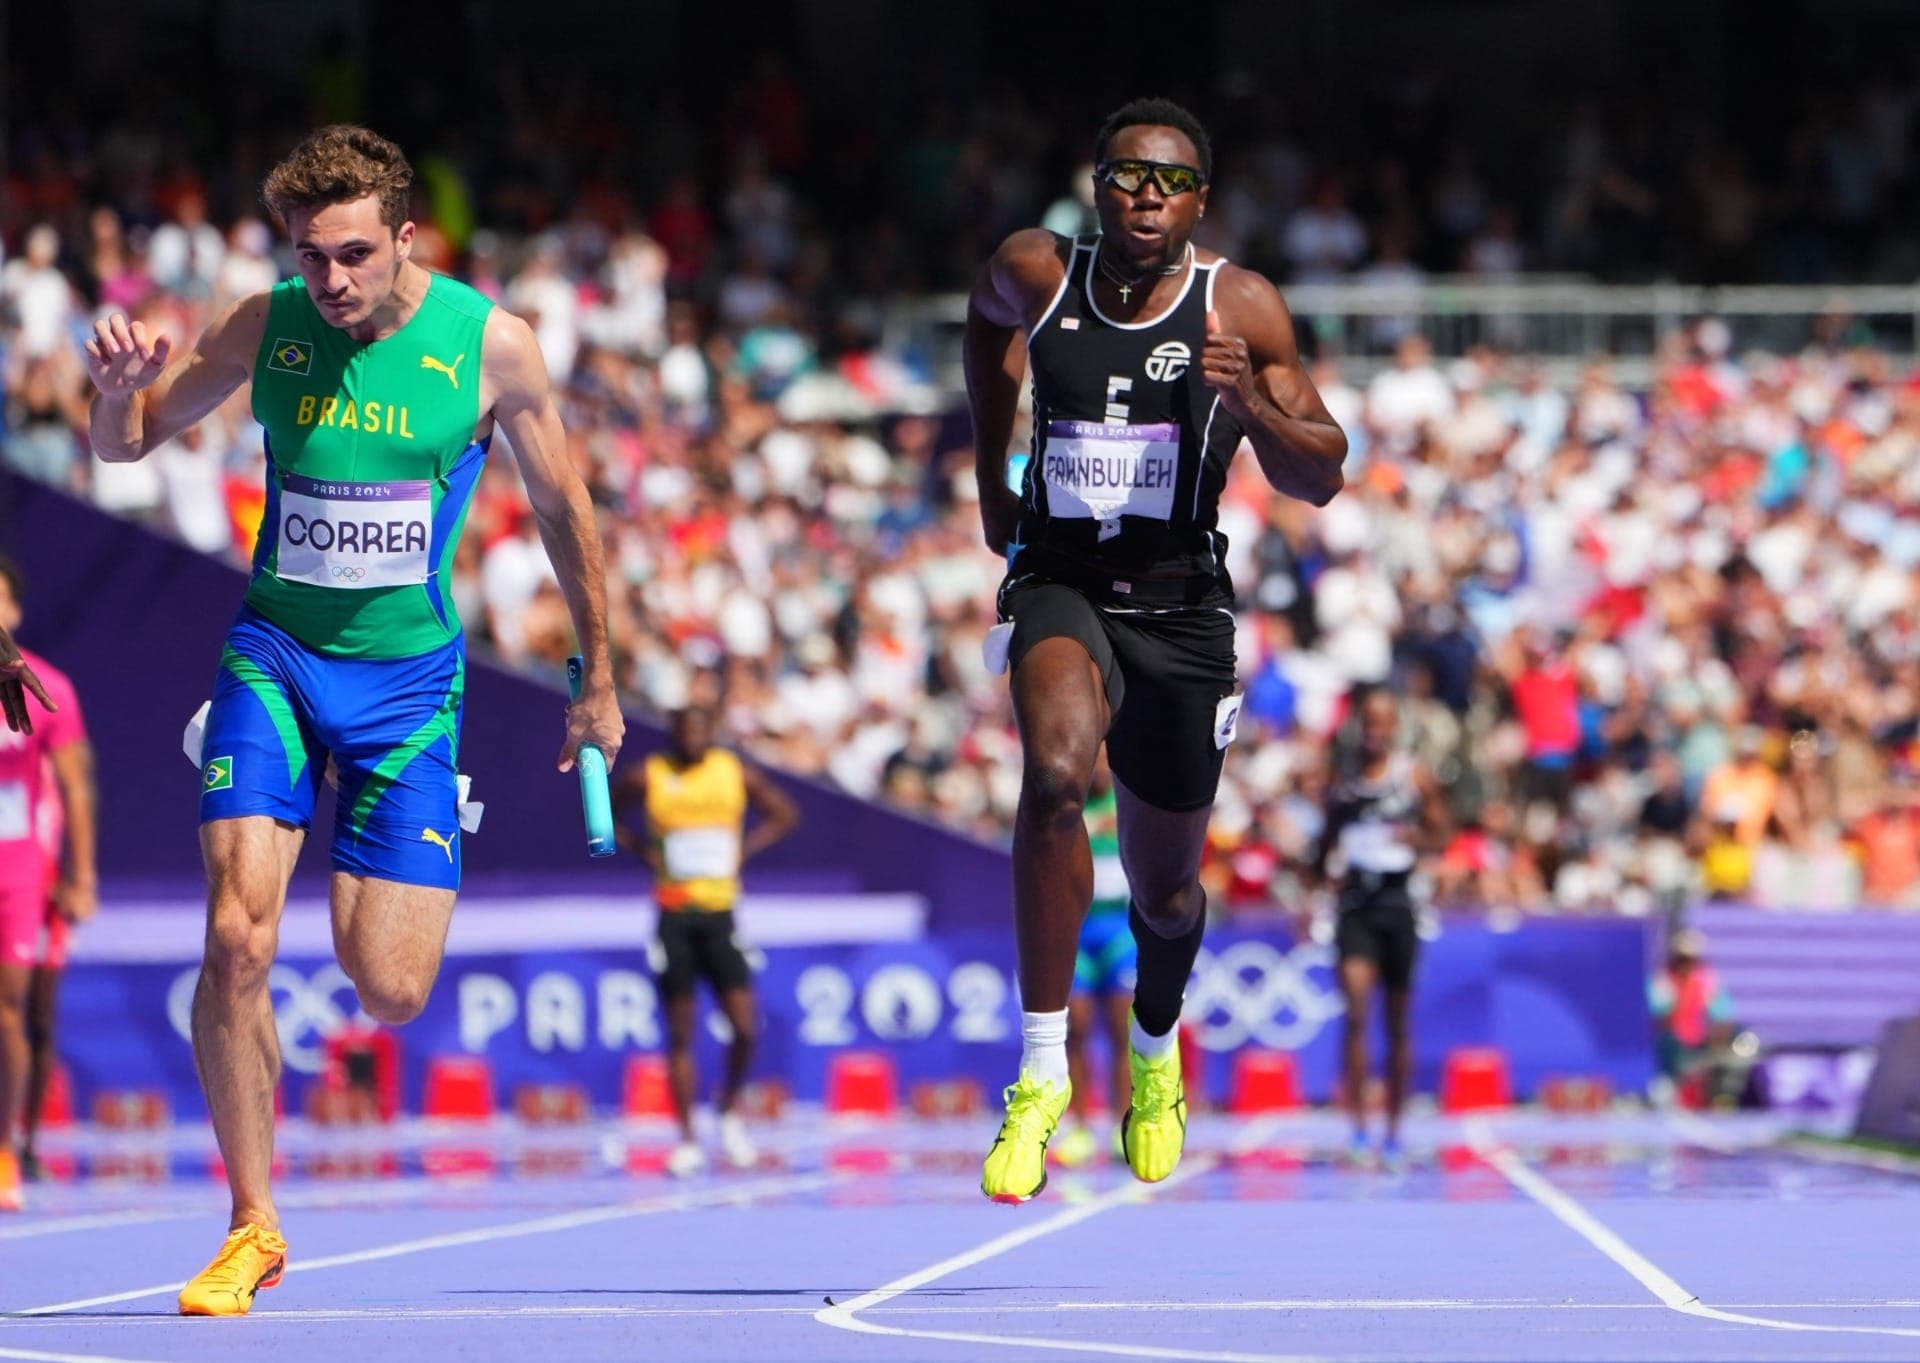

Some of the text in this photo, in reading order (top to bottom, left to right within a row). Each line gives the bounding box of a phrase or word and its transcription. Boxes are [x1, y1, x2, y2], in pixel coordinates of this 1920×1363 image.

[296, 395, 415, 439] BRASIL
[313, 483, 391, 497] PARIS 2024
[1046, 455, 1172, 488] FAHNBULLEH
[285, 512, 427, 554] CORREA
[793, 960, 1022, 1047] 202
